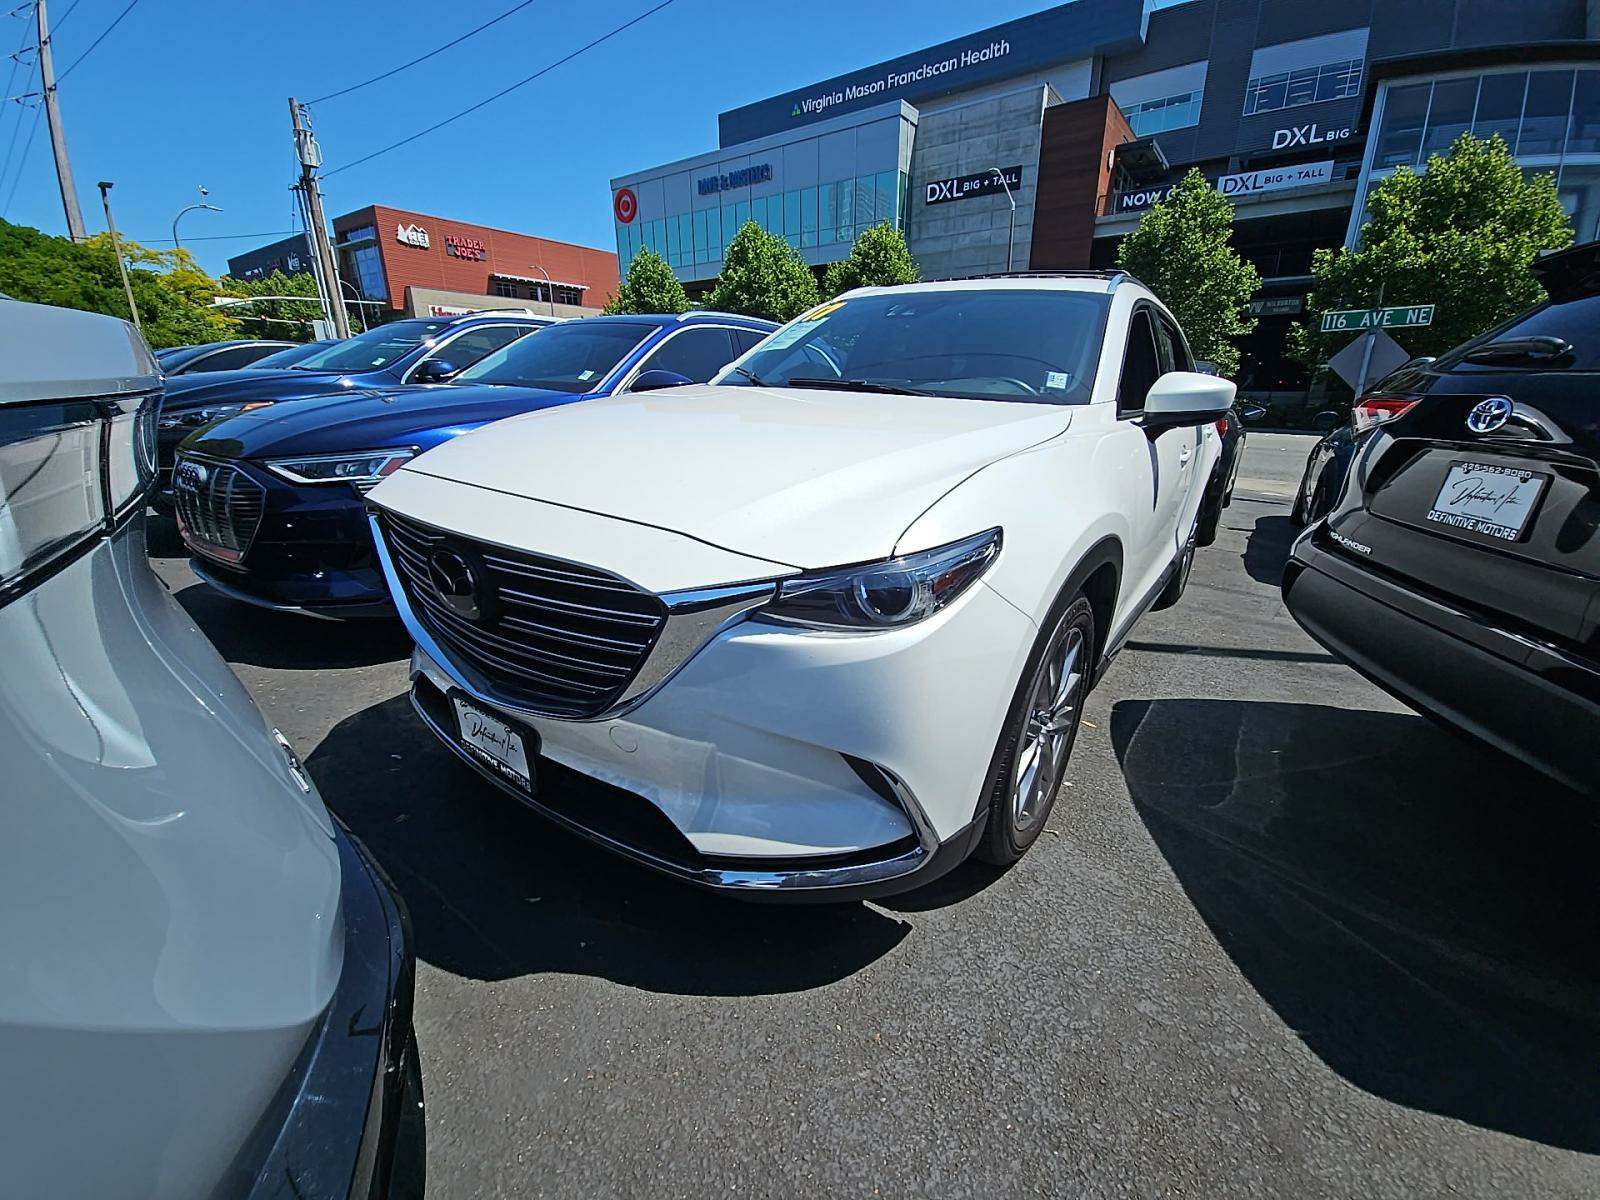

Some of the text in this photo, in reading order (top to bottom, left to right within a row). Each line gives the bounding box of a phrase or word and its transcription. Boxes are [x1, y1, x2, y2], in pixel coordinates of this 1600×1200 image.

[802, 39, 1010, 113] Virginia Mason Franciscan Health
[1272, 123, 1350, 150] DXL BIG
[926, 179, 964, 203] DXL
[963, 180, 980, 192] BIG
[993, 173, 1018, 186] TALL
[1223, 175, 1265, 194] DXL
[1264, 174, 1284, 185] BIG
[1297, 168, 1325, 180] TALL
[1122, 190, 1162, 208] NOW
[446, 234, 486, 250] TRADER
[455, 246, 481, 258] JOE'S
[1325, 308, 1431, 329] 116 AVE NE
[1427, 510, 1477, 532] DEFINITIVE
[1475, 522, 1519, 541] MOTORS
